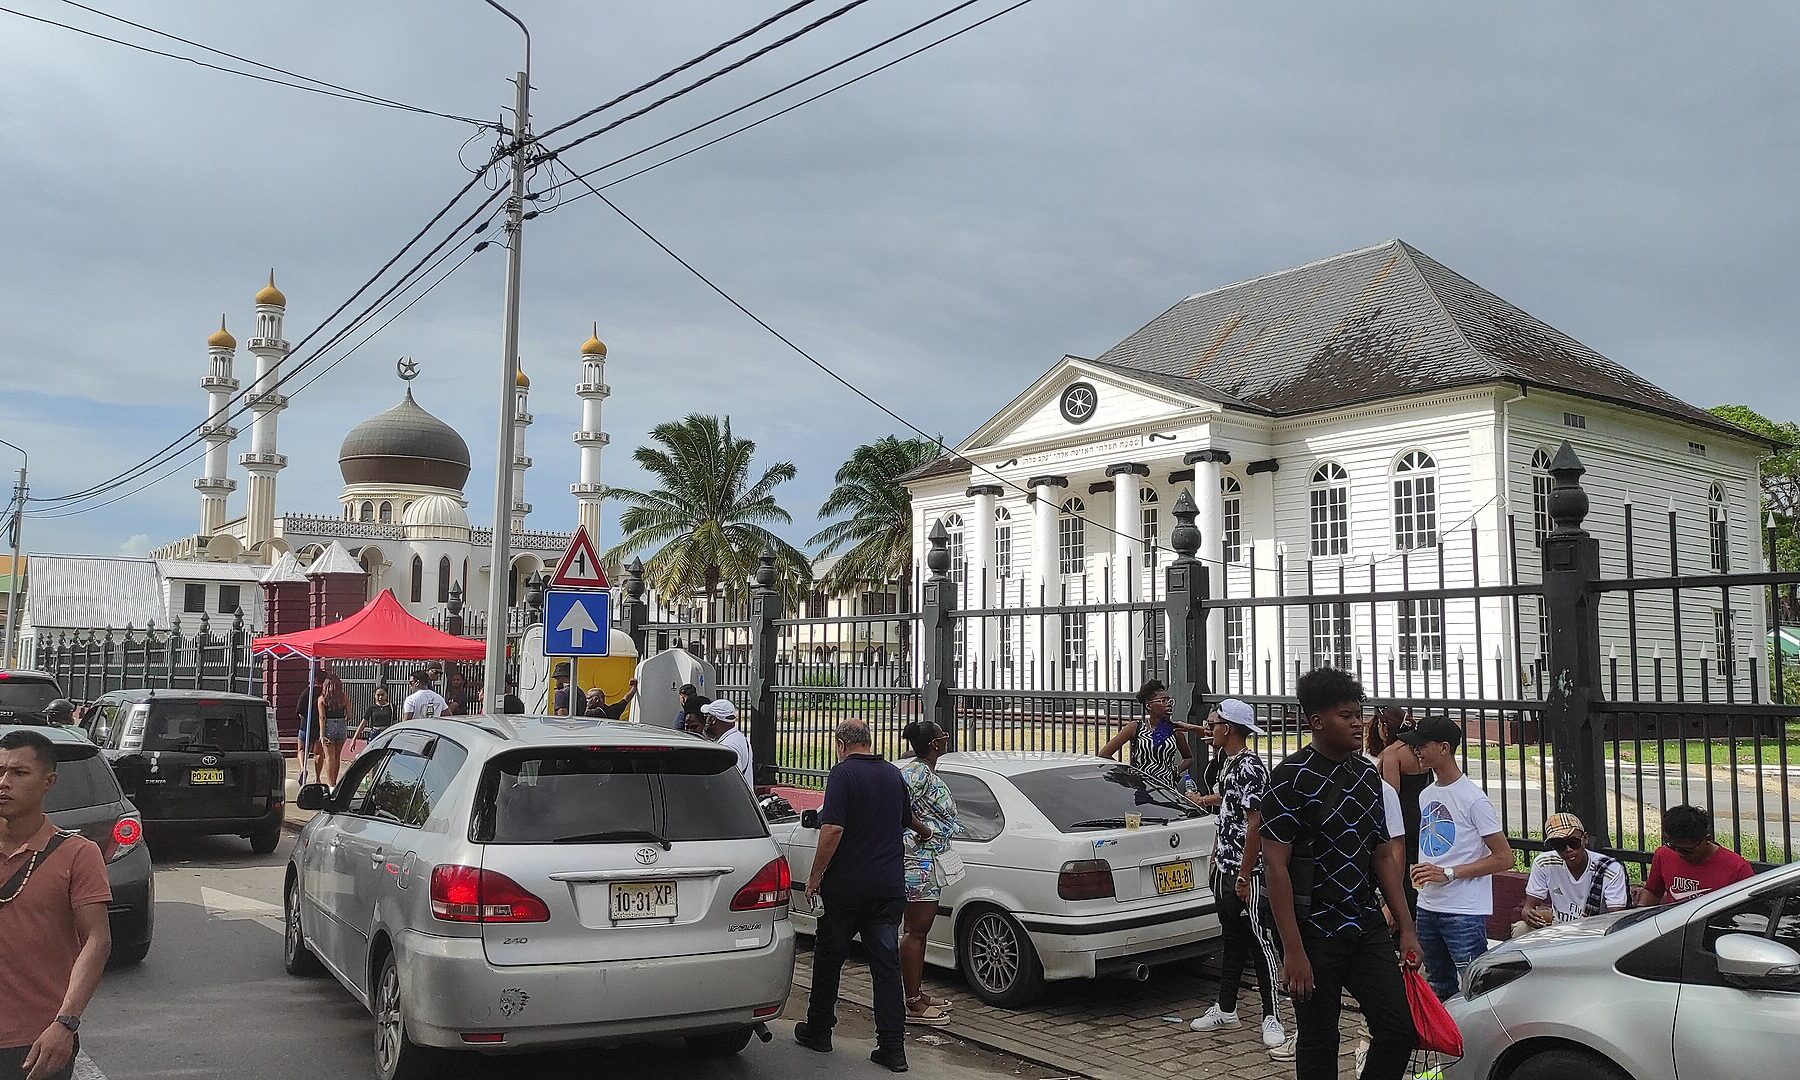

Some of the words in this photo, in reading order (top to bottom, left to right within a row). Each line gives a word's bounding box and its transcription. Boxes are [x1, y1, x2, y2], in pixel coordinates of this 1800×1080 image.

[1672, 876, 1699, 891] JUST
[654, 885, 672, 905] XP
[1569, 902, 1583, 916] Fly
